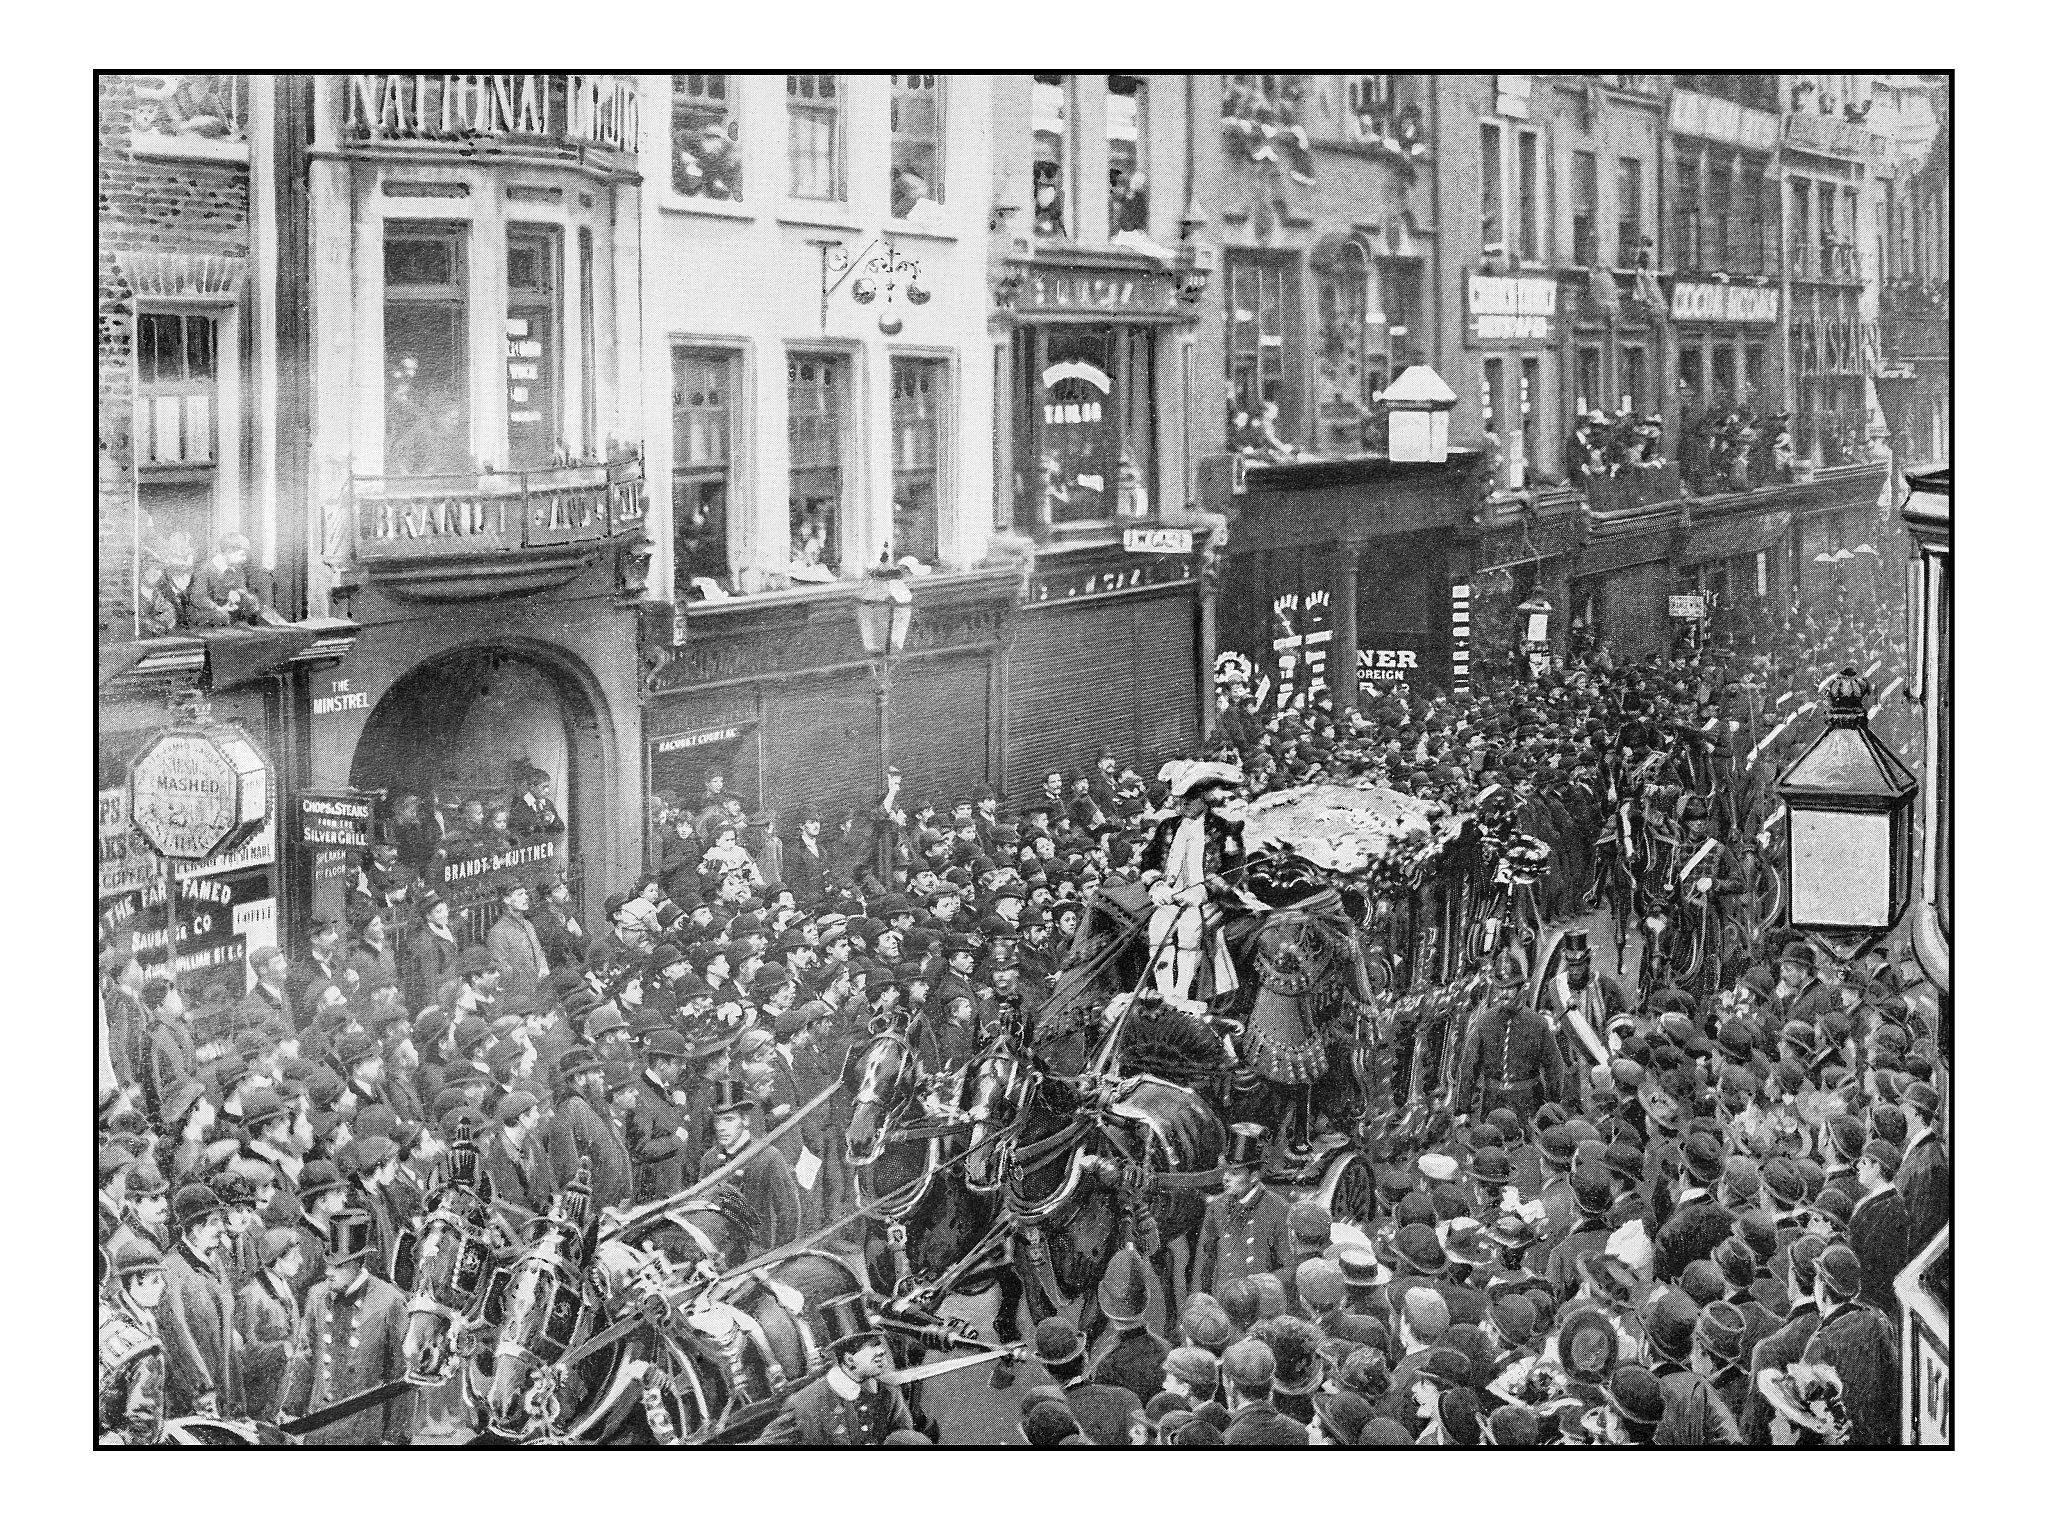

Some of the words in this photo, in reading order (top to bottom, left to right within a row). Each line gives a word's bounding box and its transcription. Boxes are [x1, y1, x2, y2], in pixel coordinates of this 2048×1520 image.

[332, 679, 350, 692] THE
[313, 692, 370, 715] MINSTREL
[157, 776, 220, 794] MASHED
[304, 827, 337, 843] SILVER
[338, 829, 368, 846] GRILL
[444, 856, 488, 882] BRANDT
[505, 841, 554, 867] KUTTNER
[104, 894, 136, 930] THE
[141, 878, 168, 908] FAR
[181, 878, 232, 905] FAMED
[193, 914, 212, 935] CO
